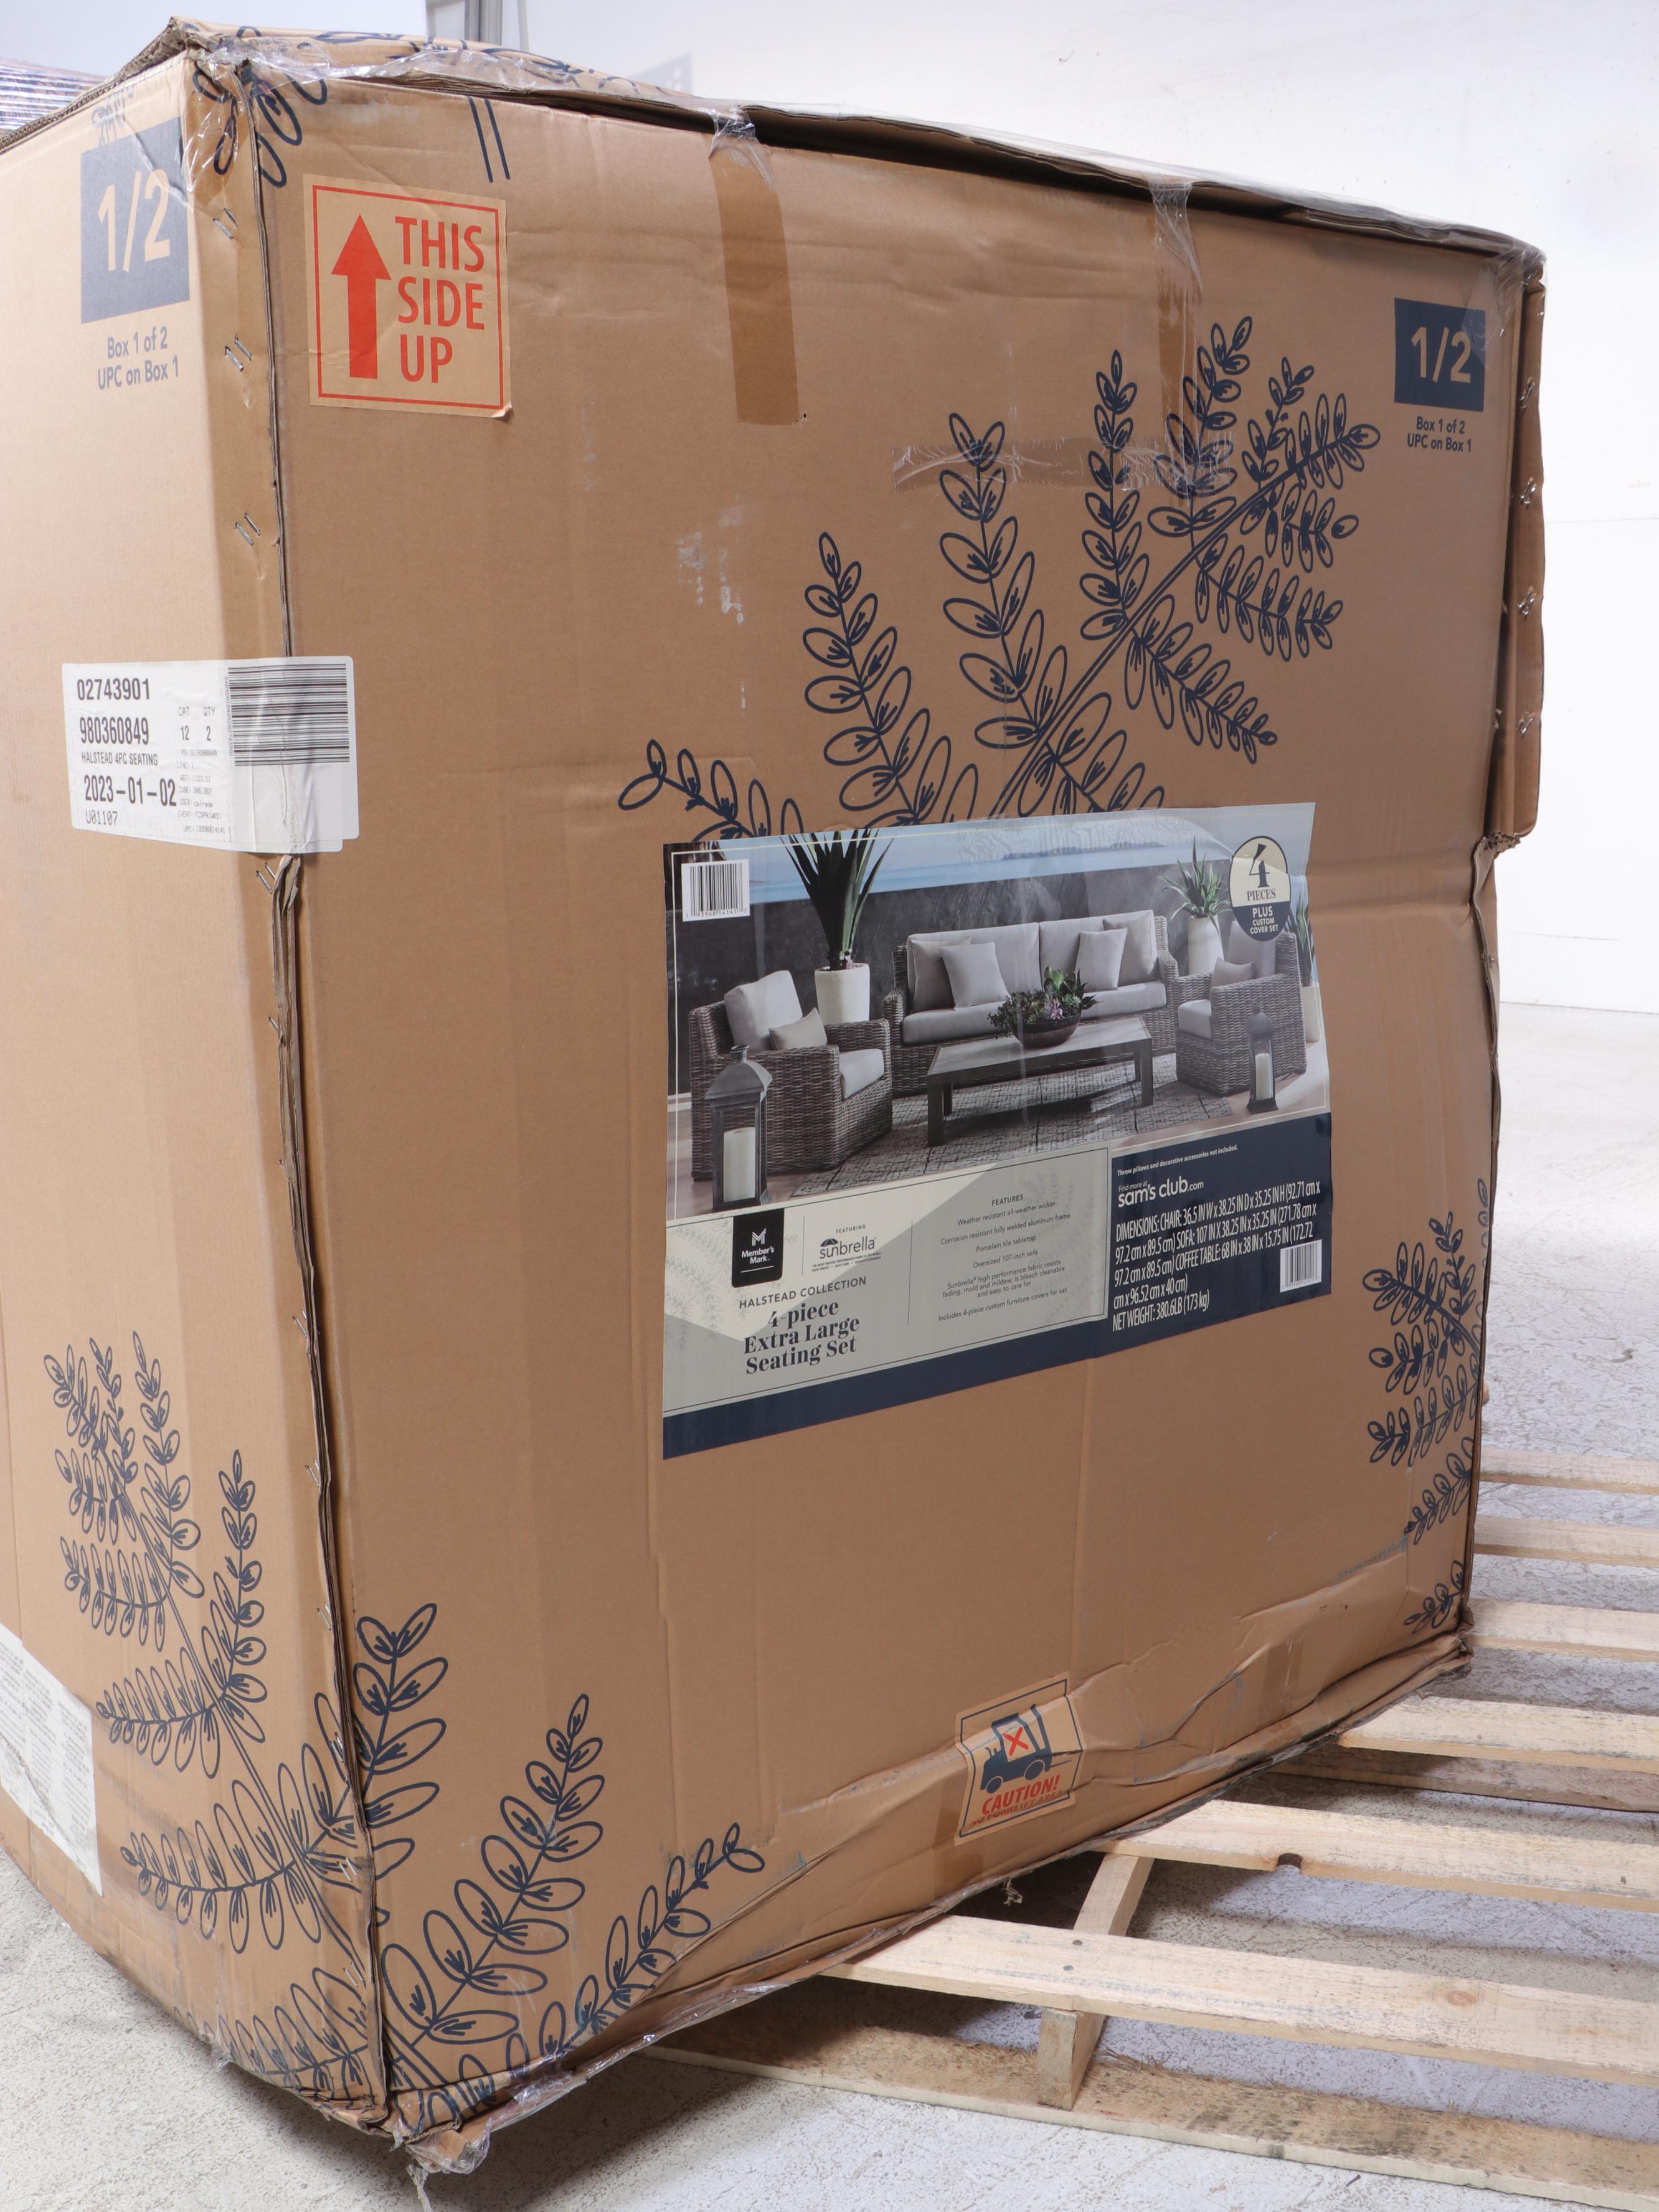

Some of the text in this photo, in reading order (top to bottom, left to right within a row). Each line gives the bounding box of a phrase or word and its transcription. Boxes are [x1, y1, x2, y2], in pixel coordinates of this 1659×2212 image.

[98, 169, 170, 273] 1/2
[395, 215, 484, 272] THIS
[398, 276, 484, 330] SIDE
[107, 326, 168, 359] Box 1 of 2
[1411, 327, 1472, 383] 1/2
[98, 354, 178, 390] UPC on Box 1
[400, 334, 453, 383] UP
[1417, 416, 1465, 434] Box 1 of 2
[1407, 433, 1472, 452] UPC on Box 1
[77, 678, 149, 701] 02743901
[178, 706, 215, 716] CAT QTY
[80, 717, 149, 745] 980360849
[181, 726, 211, 741] 12 2
[82, 752, 158, 766] HALSTEAD 4PC SEATING
[85, 809, 118, 826] U01107
[1249, 843, 1270, 888] 4
[1247, 888, 1276, 901] PIECES
[1252, 906, 1273, 918] PLUS
[1252, 917, 1275, 926] CUSTOM
[1250, 926, 1269, 934] COVER
[1133, 1165, 1149, 1174] pillows
[1160, 1157, 1183, 1167] decorative
[1184, 1152, 1209, 1161] accessories
[1217, 1144, 1238, 1155] included.
[991, 1194, 1024, 1206] FEATURES
[1118, 1184, 1128, 1193] Find
[1118, 1184, 1156, 1208] sam's
[957, 1201, 1056, 1226] Weather resistant all-weather wicker
[1116, 1181, 1305, 1242] DIMENSIONS: CHAIR: 36.5 38.25 35.25 (92.71
[836, 1224, 866, 1234] FEATURING
[941, 1235, 968, 1244] Corrosion
[970, 1229, 993, 1238] resistant
[1007, 1221, 1027, 1231] welded
[1028, 1217, 1054, 1227] aluminum
[1115, 1244, 1130, 1265] 97.2
[1147, 1237, 1161, 1257] 89.5
[1163, 1232, 1175, 1253] cm)
[1177, 1229, 1195, 1249] SOFA:
[1196, 1226, 1208, 1244] 107
[1222, 1217, 1239, 1237] 38.25
[1252, 1210, 1269, 1230] 35.25
[1278, 1203, 1301, 1226] (271.78
[741, 1246, 775, 1258] Member's
[976, 1242, 1001, 1252] Porcelain
[1013, 1236, 1036, 1245] tabletop
[1115, 1267, 1129, 1287] 97.2
[1146, 1259, 1161, 1279] 89.5
[1162, 1255, 1175, 1275] cm)
[1176, 1249, 1198, 1271] COFFEE
[1200, 1244, 1221, 1265] TABLE:
[1221, 1241, 1230, 1259] 68
[1243, 1236, 1251, 1254] 38
[1264, 1227, 1281, 1248] 15.75
[1290, 1221, 1313, 1244] (172.72
[973, 1258, 1001, 1269] Oversized
[1003, 1253, 1025, 1262] 107-inch
[978, 1275, 990, 1283] high
[991, 1267, 1026, 1280] performance
[1044, 1259, 1061, 1267] resists
[739, 1276, 867, 1309] HALSTEAD COLLECTION
[943, 1289, 962, 1298] fading,
[963, 1285, 978, 1293] mold
[1020, 1272, 1038, 1280] bleach
[1039, 1266, 1065, 1276] cleanable
[1130, 1284, 1149, 1305] 96.52
[1166, 1277, 1175, 1295] 40
[1175, 1274, 1188, 1293] cm)
[768, 1302, 839, 1329] 4-piece
[938, 1309, 962, 1321] Includes
[963, 1306, 984, 1316] 4-piece
[985, 1302, 1005, 1311] custom
[1006, 1296, 1029, 1306] furniture
[1031, 1292, 1049, 1300] covers
[1113, 1289, 1209, 1332] NET WEIGHT: 380.6LB (173 kg)
[744, 1318, 859, 1354] Extra Large
[746, 1336, 857, 1374] Seating Set
[982, 1774, 1061, 1815] CAUTION!
